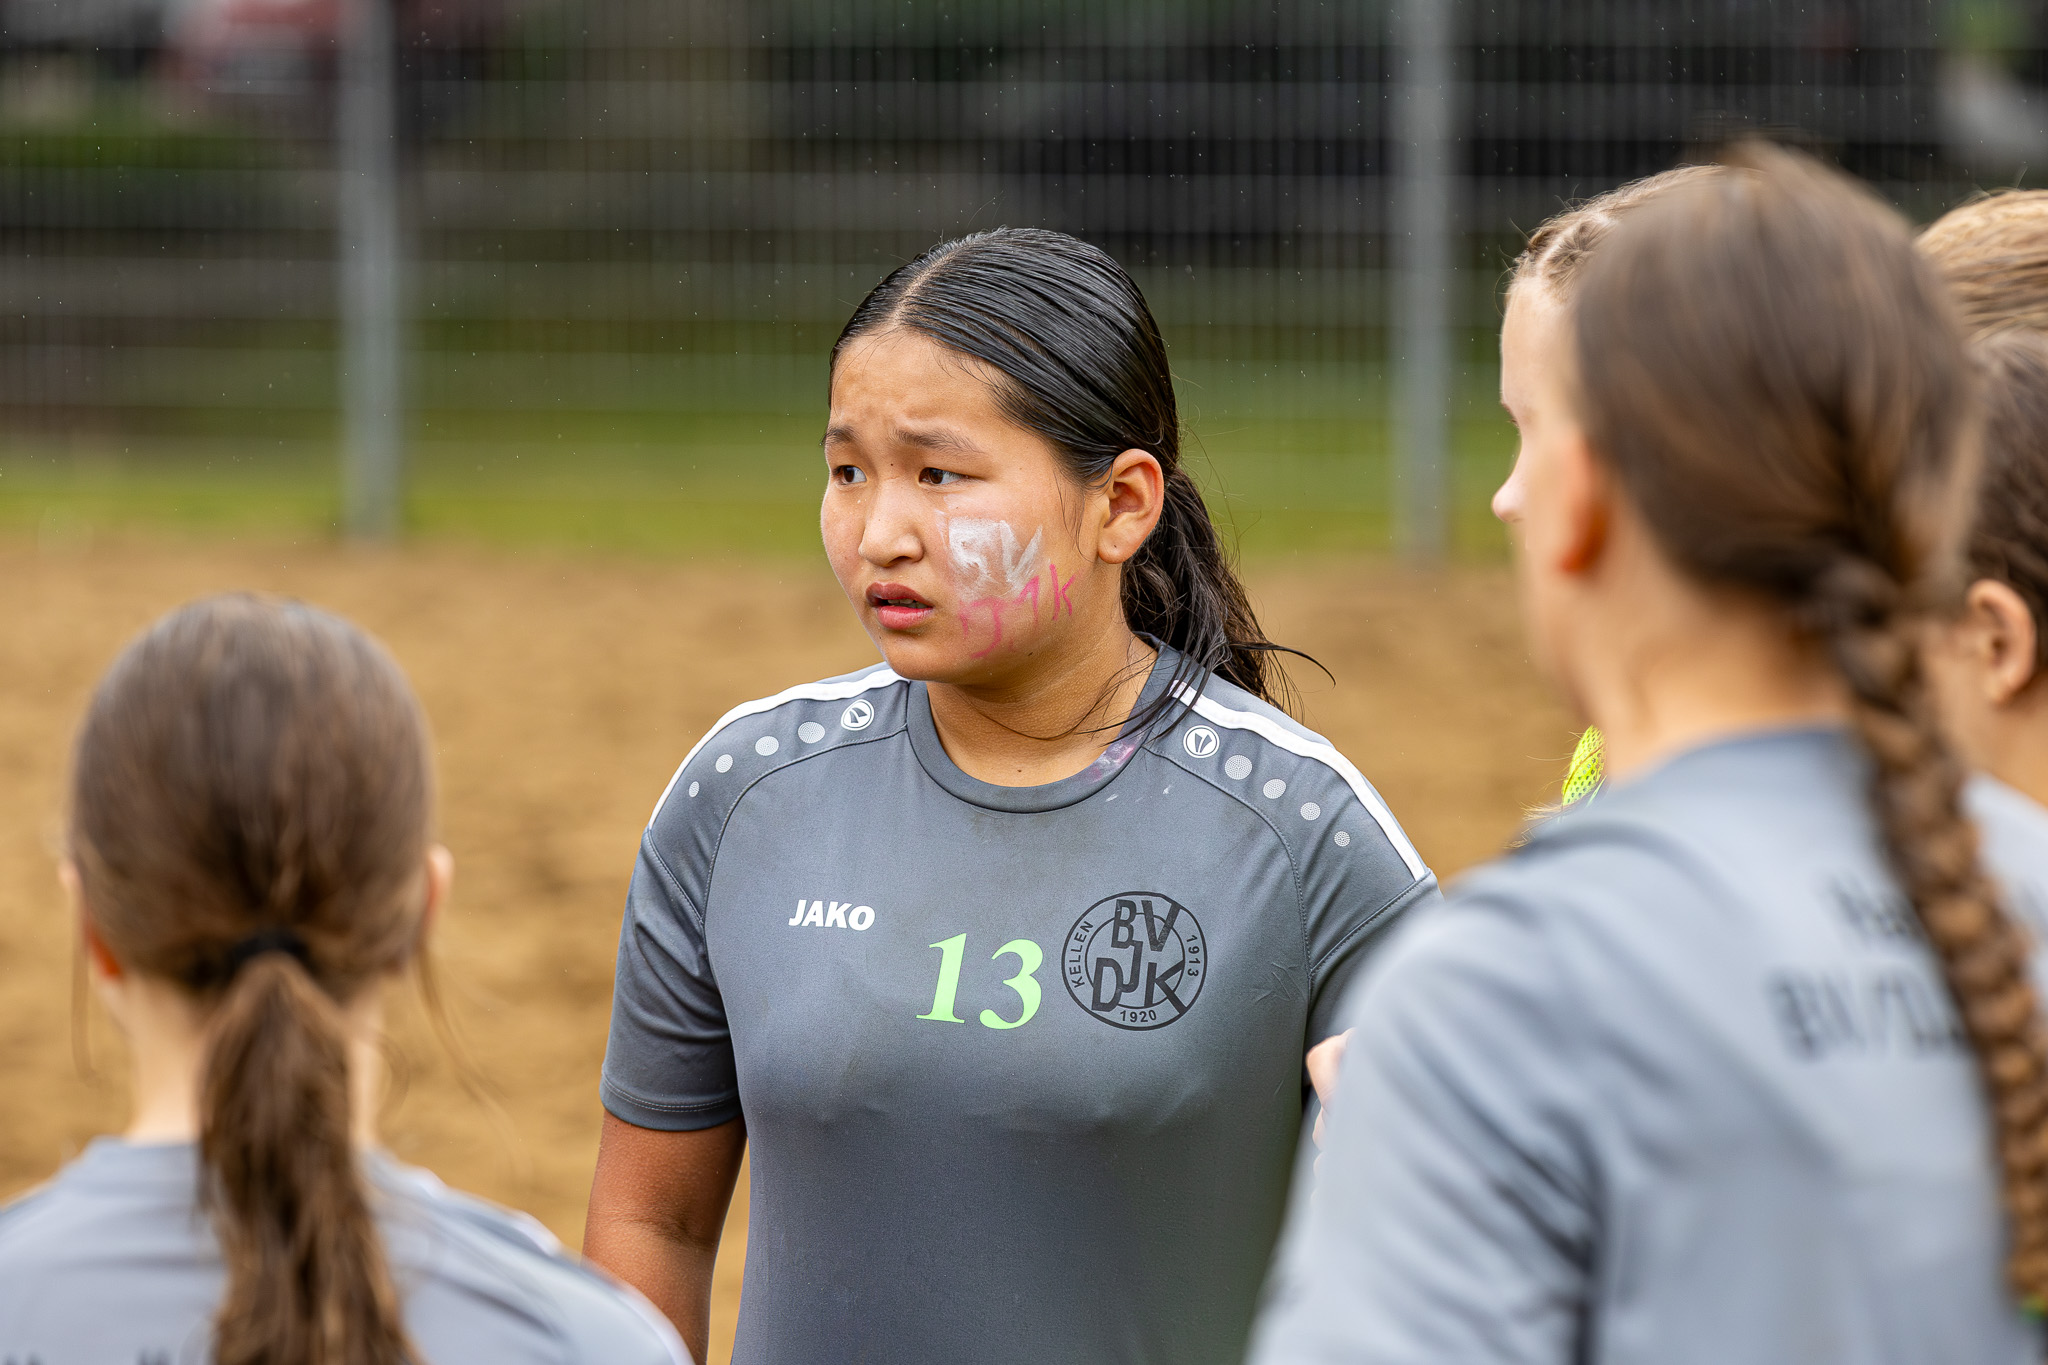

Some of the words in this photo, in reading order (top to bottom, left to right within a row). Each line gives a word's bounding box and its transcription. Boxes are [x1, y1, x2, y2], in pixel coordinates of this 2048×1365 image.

[789, 899, 875, 931] JAKO
[1069, 921, 1094, 988] KELLEN
[1186, 934, 1201, 977] 1913
[916, 933, 1044, 1029] 13
[1119, 1009, 1157, 1023] 1920
